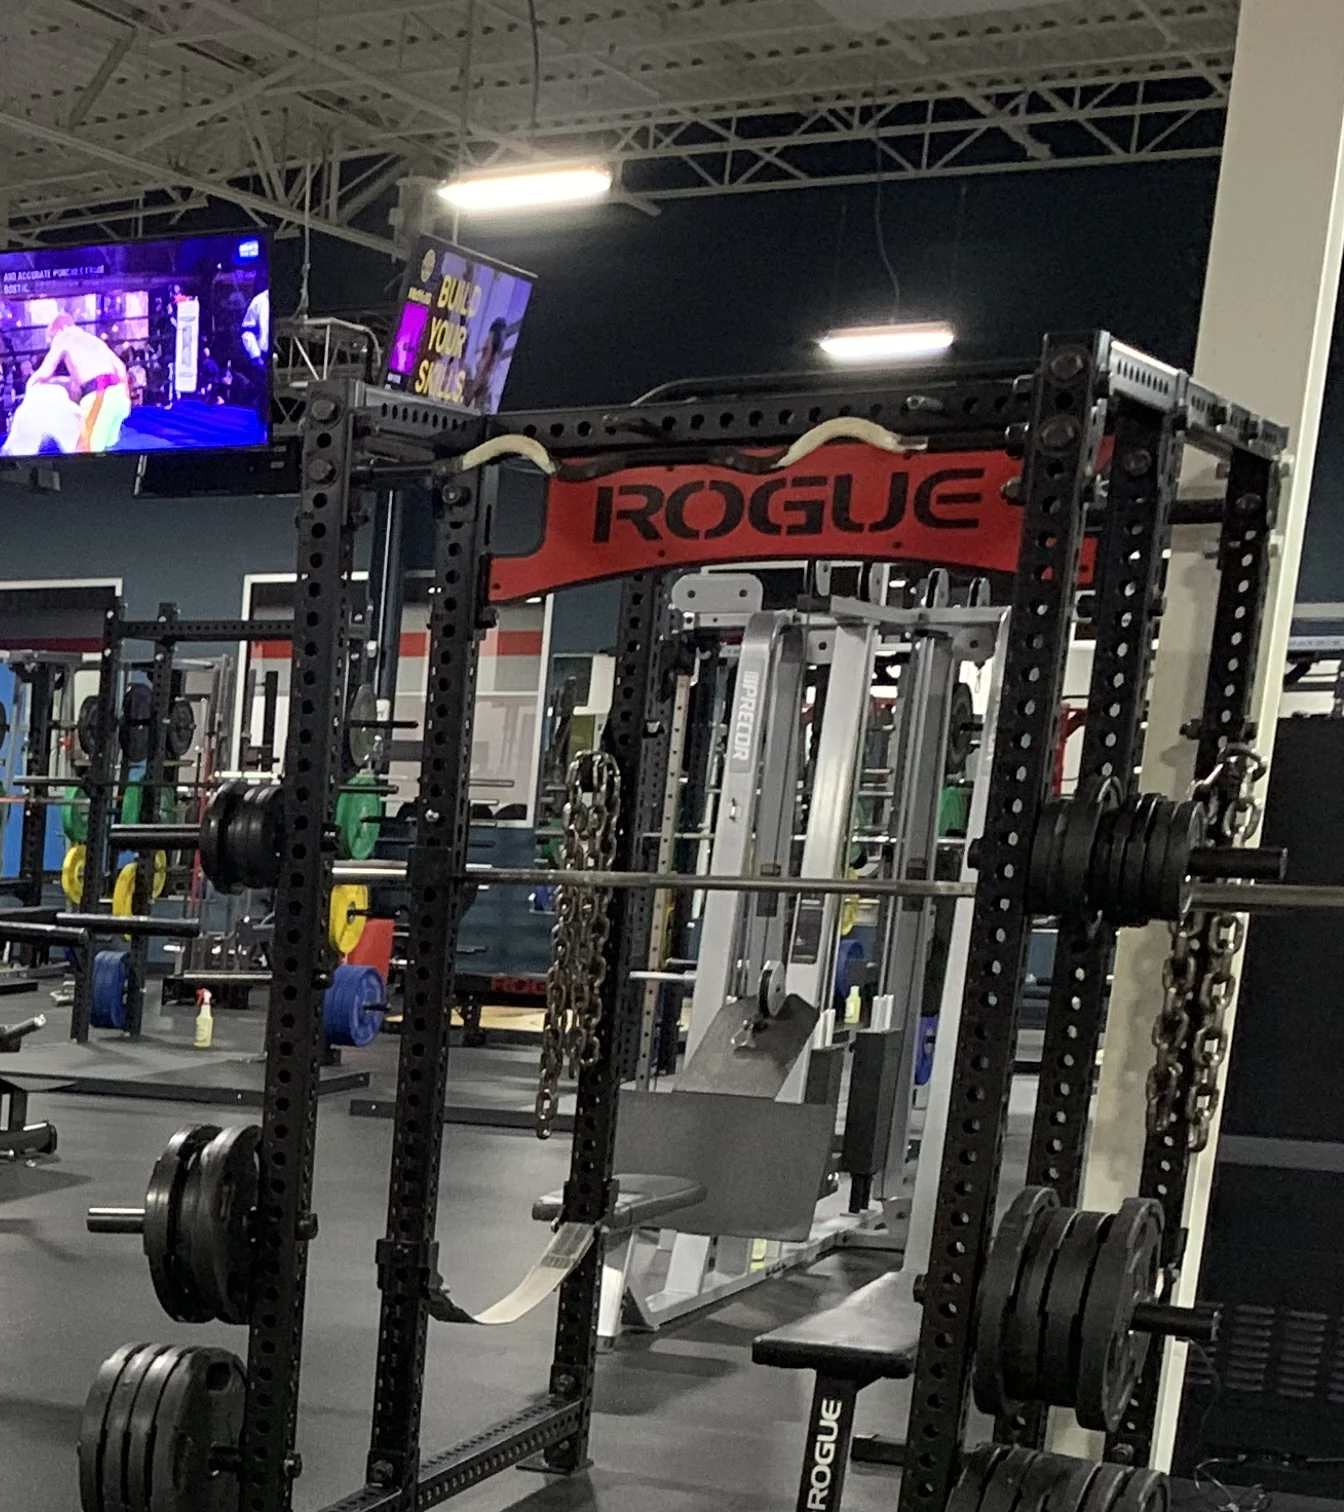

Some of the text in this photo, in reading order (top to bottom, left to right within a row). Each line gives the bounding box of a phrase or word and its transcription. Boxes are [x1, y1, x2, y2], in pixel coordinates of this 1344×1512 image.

[437, 275, 482, 317] BUILD
[428, 316, 467, 359] YOUR
[592, 468, 985, 544] ROGUE
[732, 683, 758, 761] PRECOR
[806, 1397, 843, 1511] ROGUE
